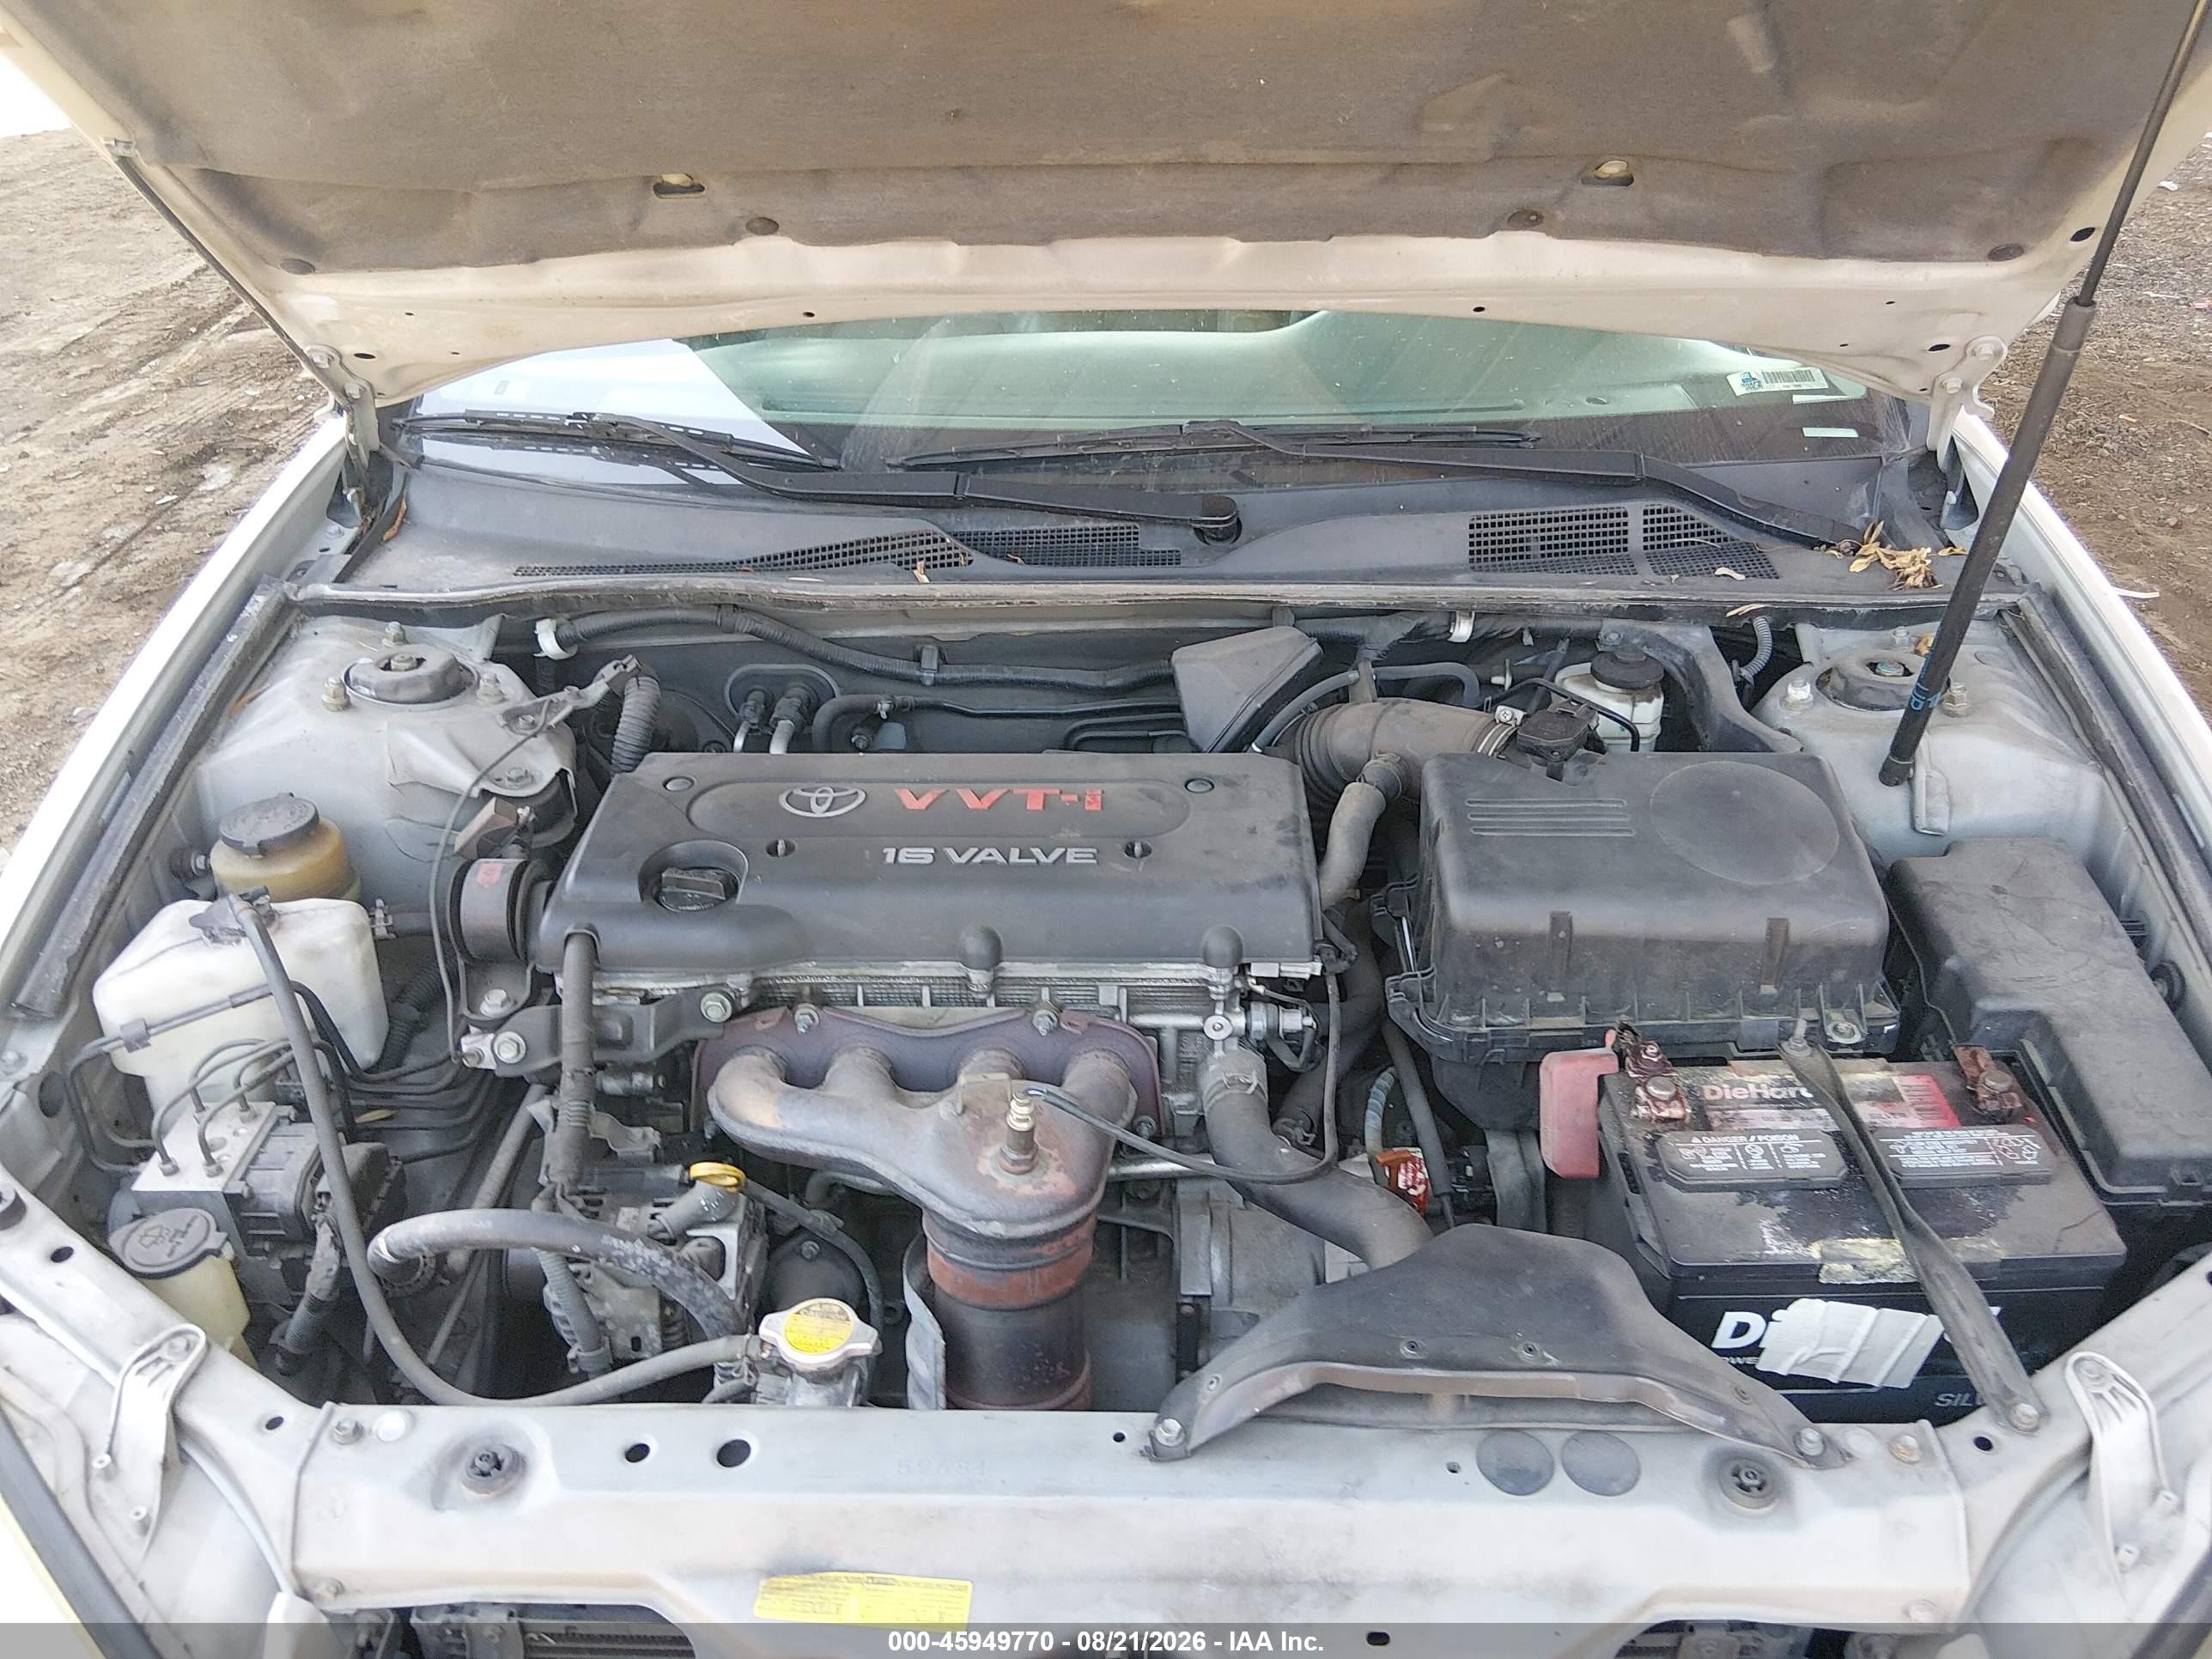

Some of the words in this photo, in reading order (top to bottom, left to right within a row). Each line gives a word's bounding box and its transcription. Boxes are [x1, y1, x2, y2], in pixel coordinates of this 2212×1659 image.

[894, 787, 1103, 811] VVT-i
[883, 847, 935, 865] 16
[944, 847, 1099, 866] VALVE
[1701, 1135, 1748, 1144] DANGER
[1756, 1133, 1801, 1142] POISON
